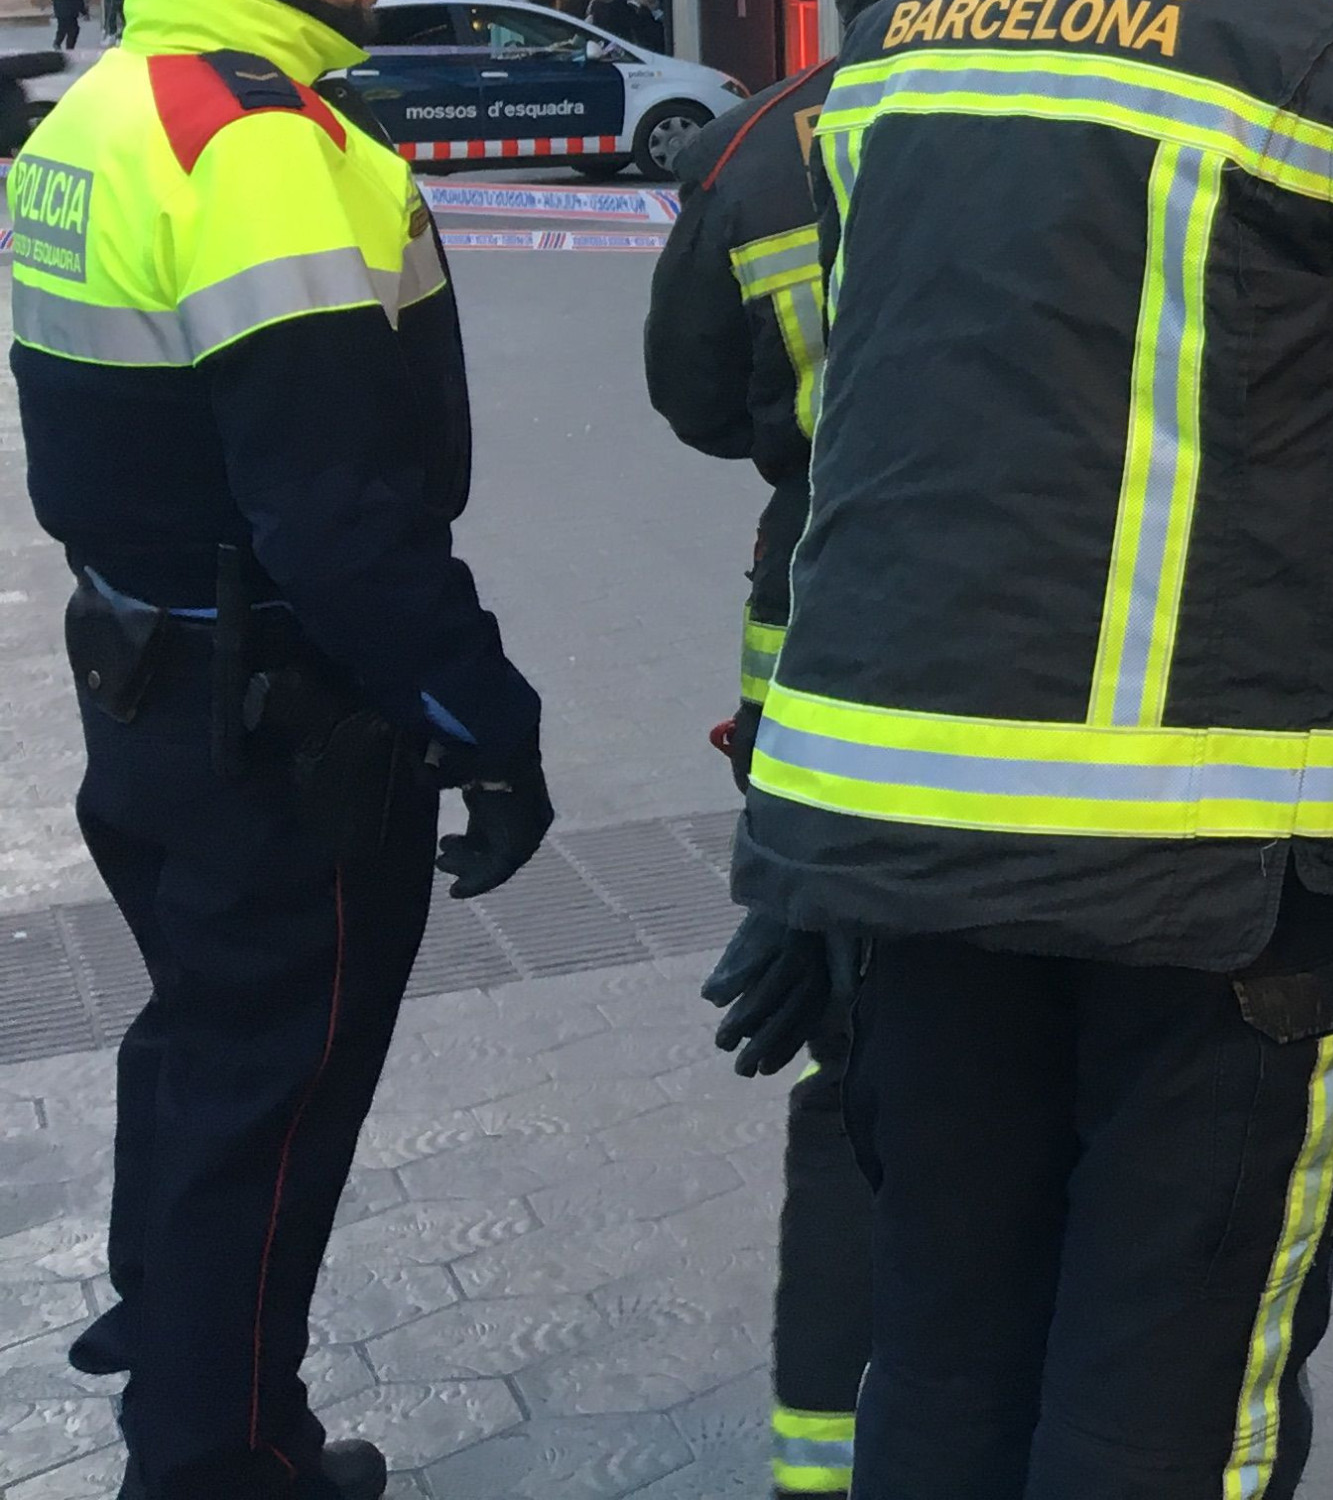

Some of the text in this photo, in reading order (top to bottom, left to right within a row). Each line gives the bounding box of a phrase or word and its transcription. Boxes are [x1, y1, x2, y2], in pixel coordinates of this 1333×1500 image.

[406, 99, 585, 120] mossos d'esquadra
[15, 161, 85, 234] POLICIA
